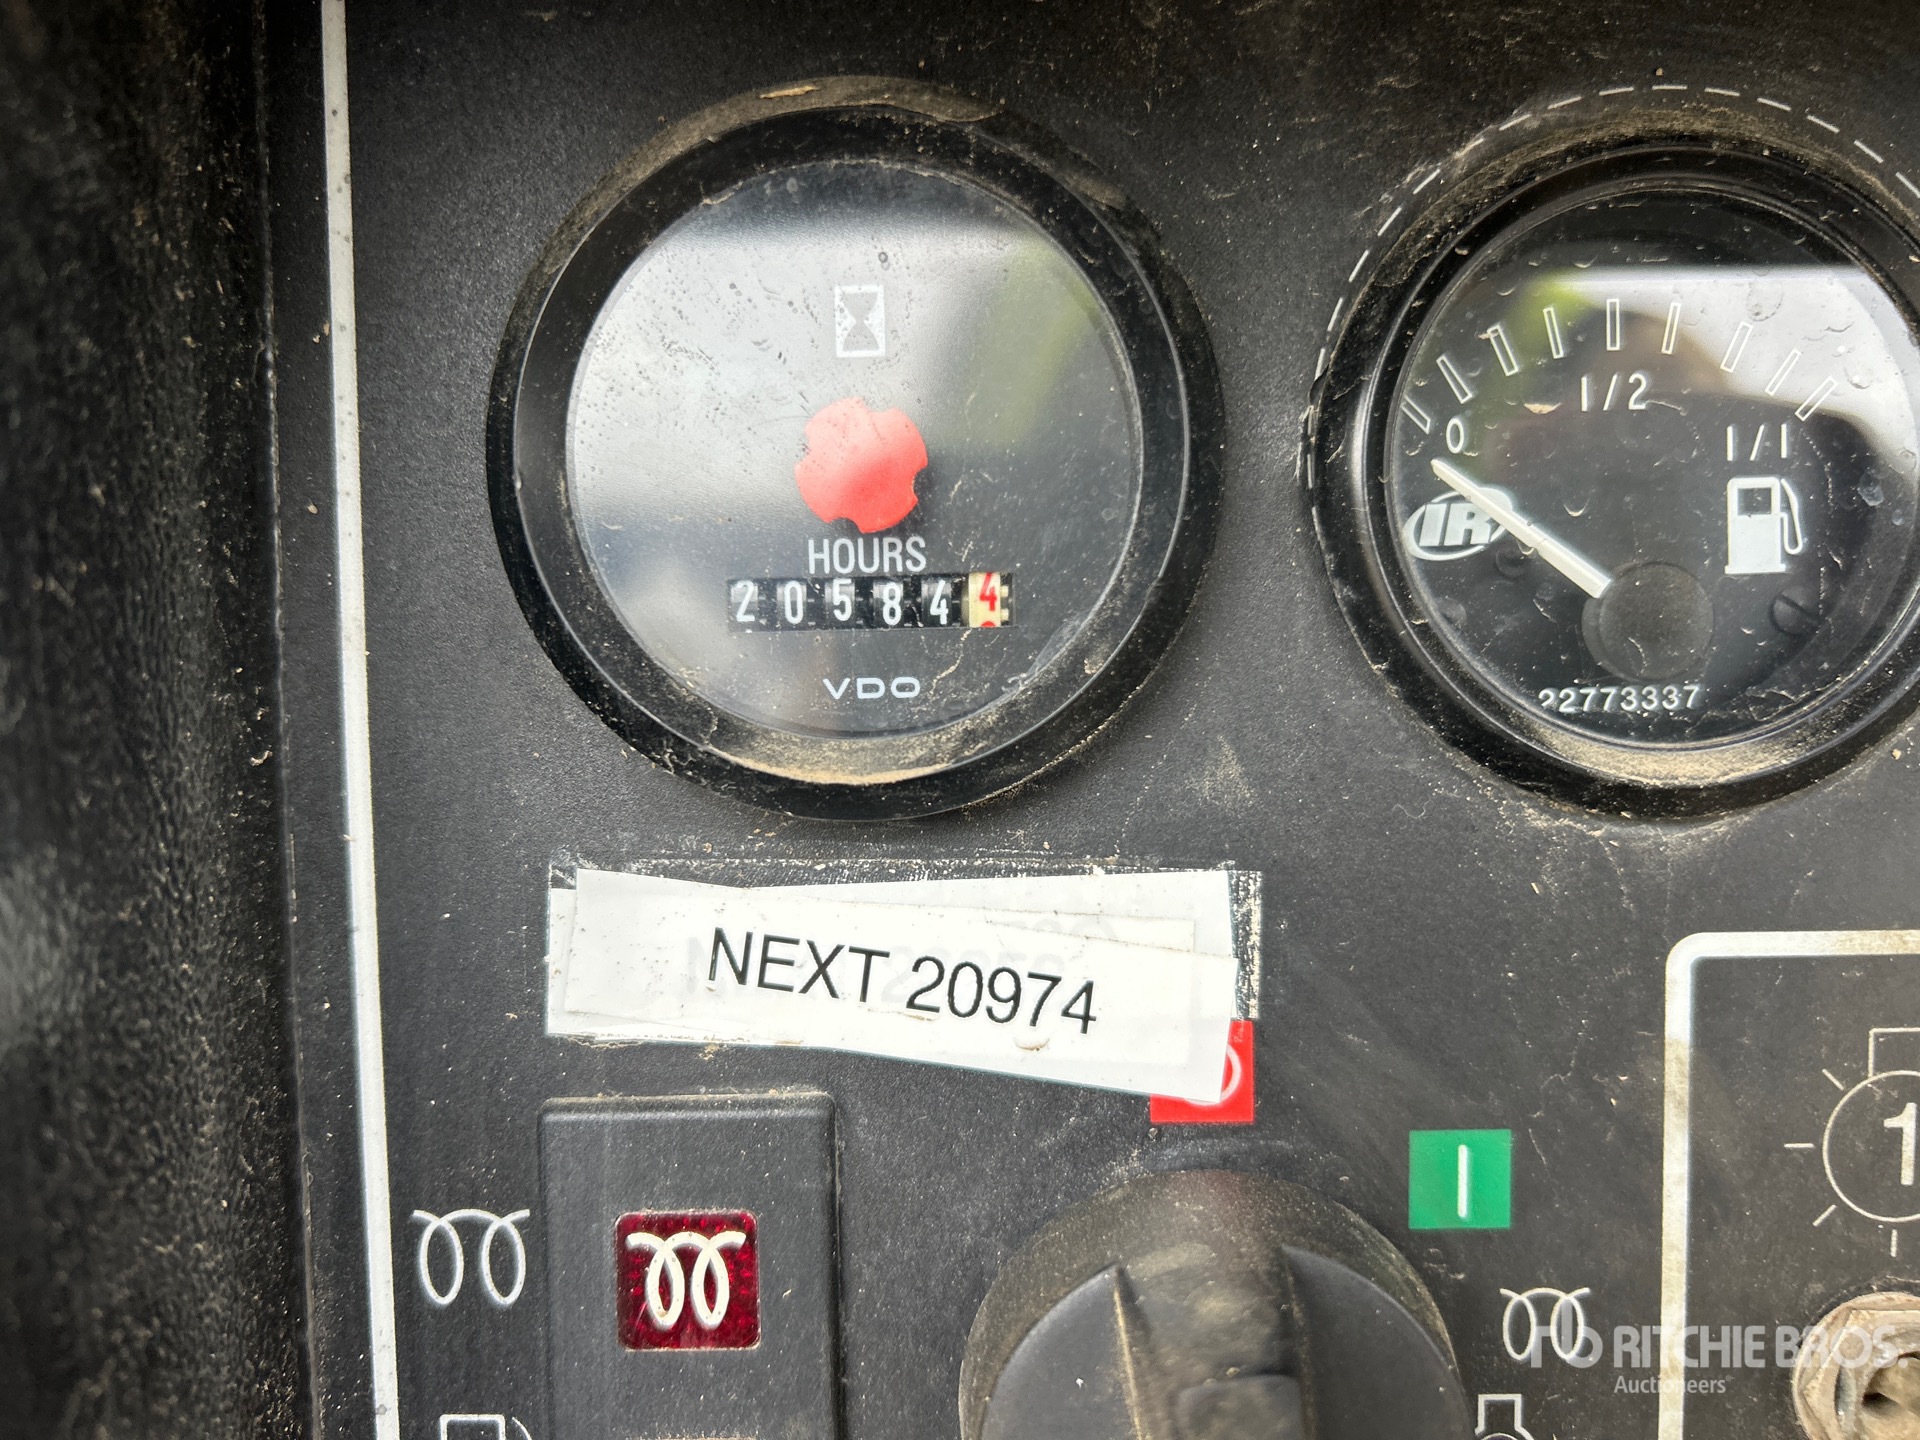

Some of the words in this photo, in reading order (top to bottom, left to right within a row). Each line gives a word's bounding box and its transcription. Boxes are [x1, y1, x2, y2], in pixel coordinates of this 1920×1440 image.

[1580, 373, 1648, 411] 1/2
[807, 536, 927, 574] HOURS
[822, 677, 920, 700] VDO
[1537, 686, 1700, 713] 22773337
[708, 927, 890, 1003] NEXT
[906, 956, 1097, 1035] 20974
